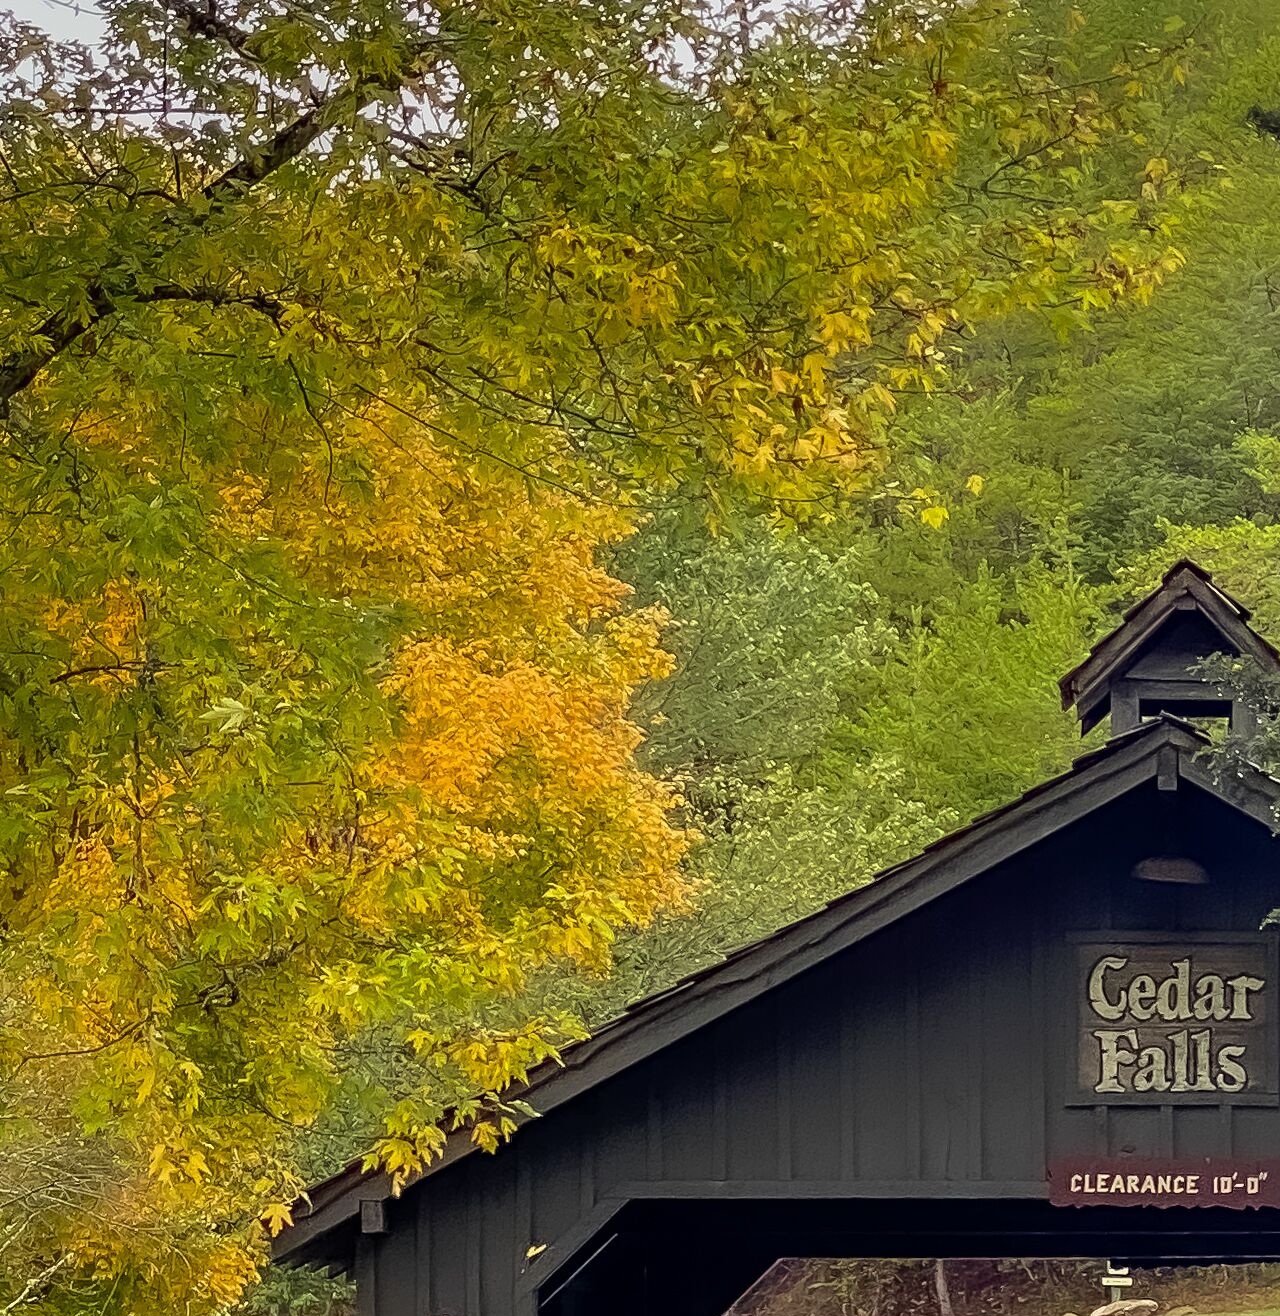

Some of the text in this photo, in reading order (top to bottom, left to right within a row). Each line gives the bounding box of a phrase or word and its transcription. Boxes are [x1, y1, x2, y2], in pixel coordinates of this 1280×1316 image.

[1088, 956, 1266, 1021] Cedar
[1093, 1029, 1247, 1093] Falls
[1070, 1173, 1200, 1194] CLEARANCE
